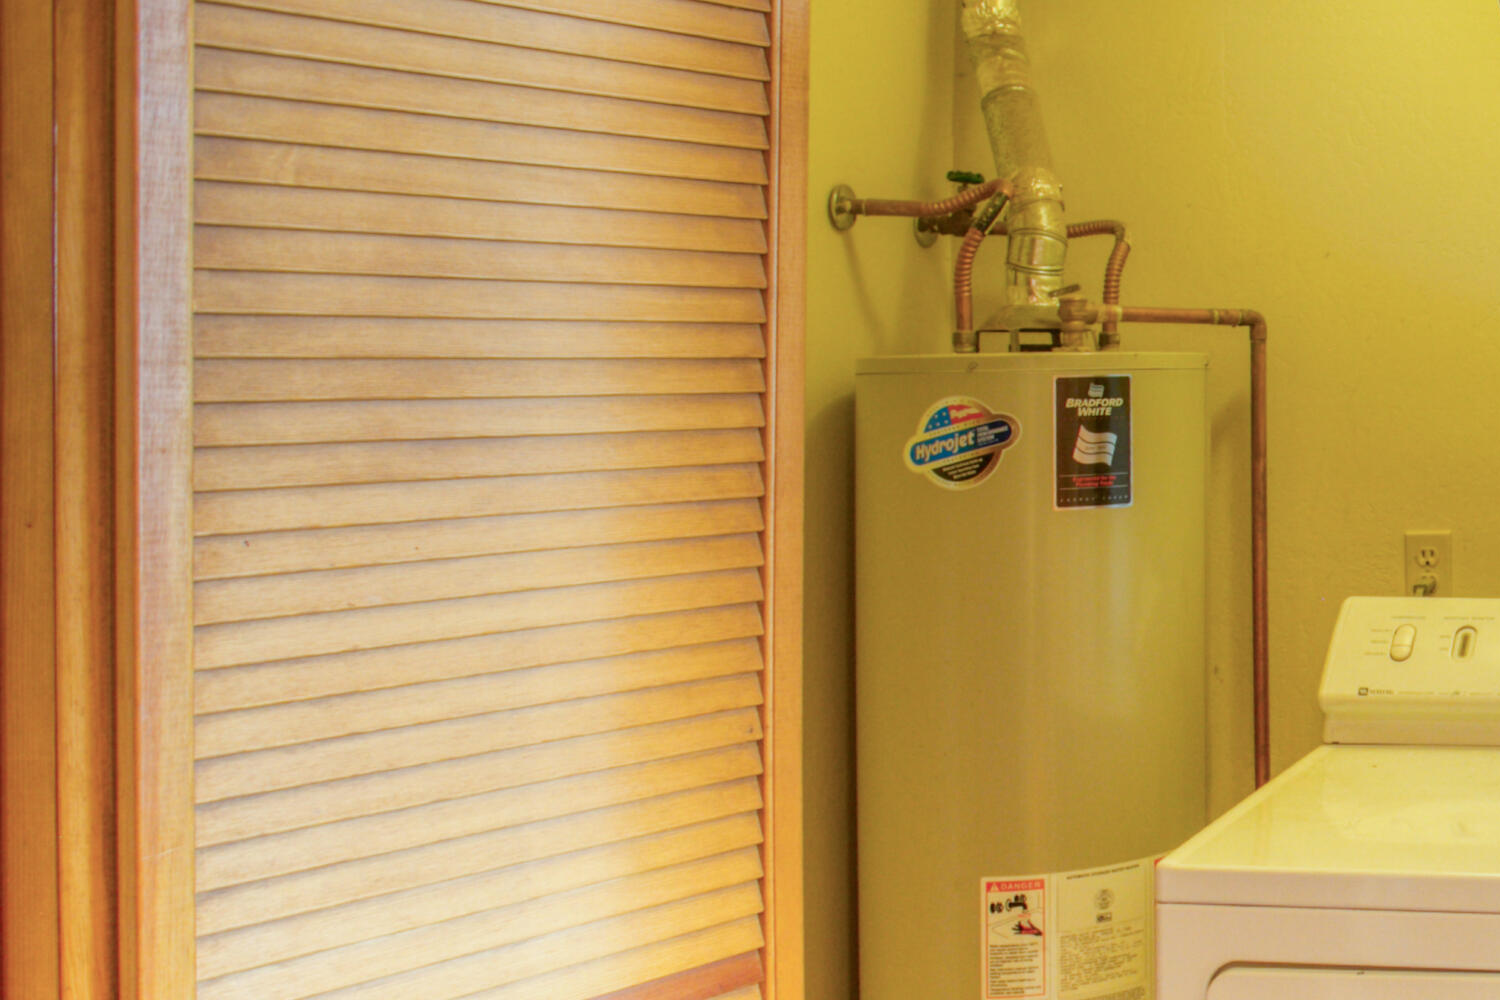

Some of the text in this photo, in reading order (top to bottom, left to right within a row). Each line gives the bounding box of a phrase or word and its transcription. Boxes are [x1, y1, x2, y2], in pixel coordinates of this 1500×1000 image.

[1065, 398, 1124, 409] BRADFORD
[1078, 407, 1112, 417] WHITE
[915, 432, 975, 462] Hydrojet
[999, 881, 1042, 891] DANGER
